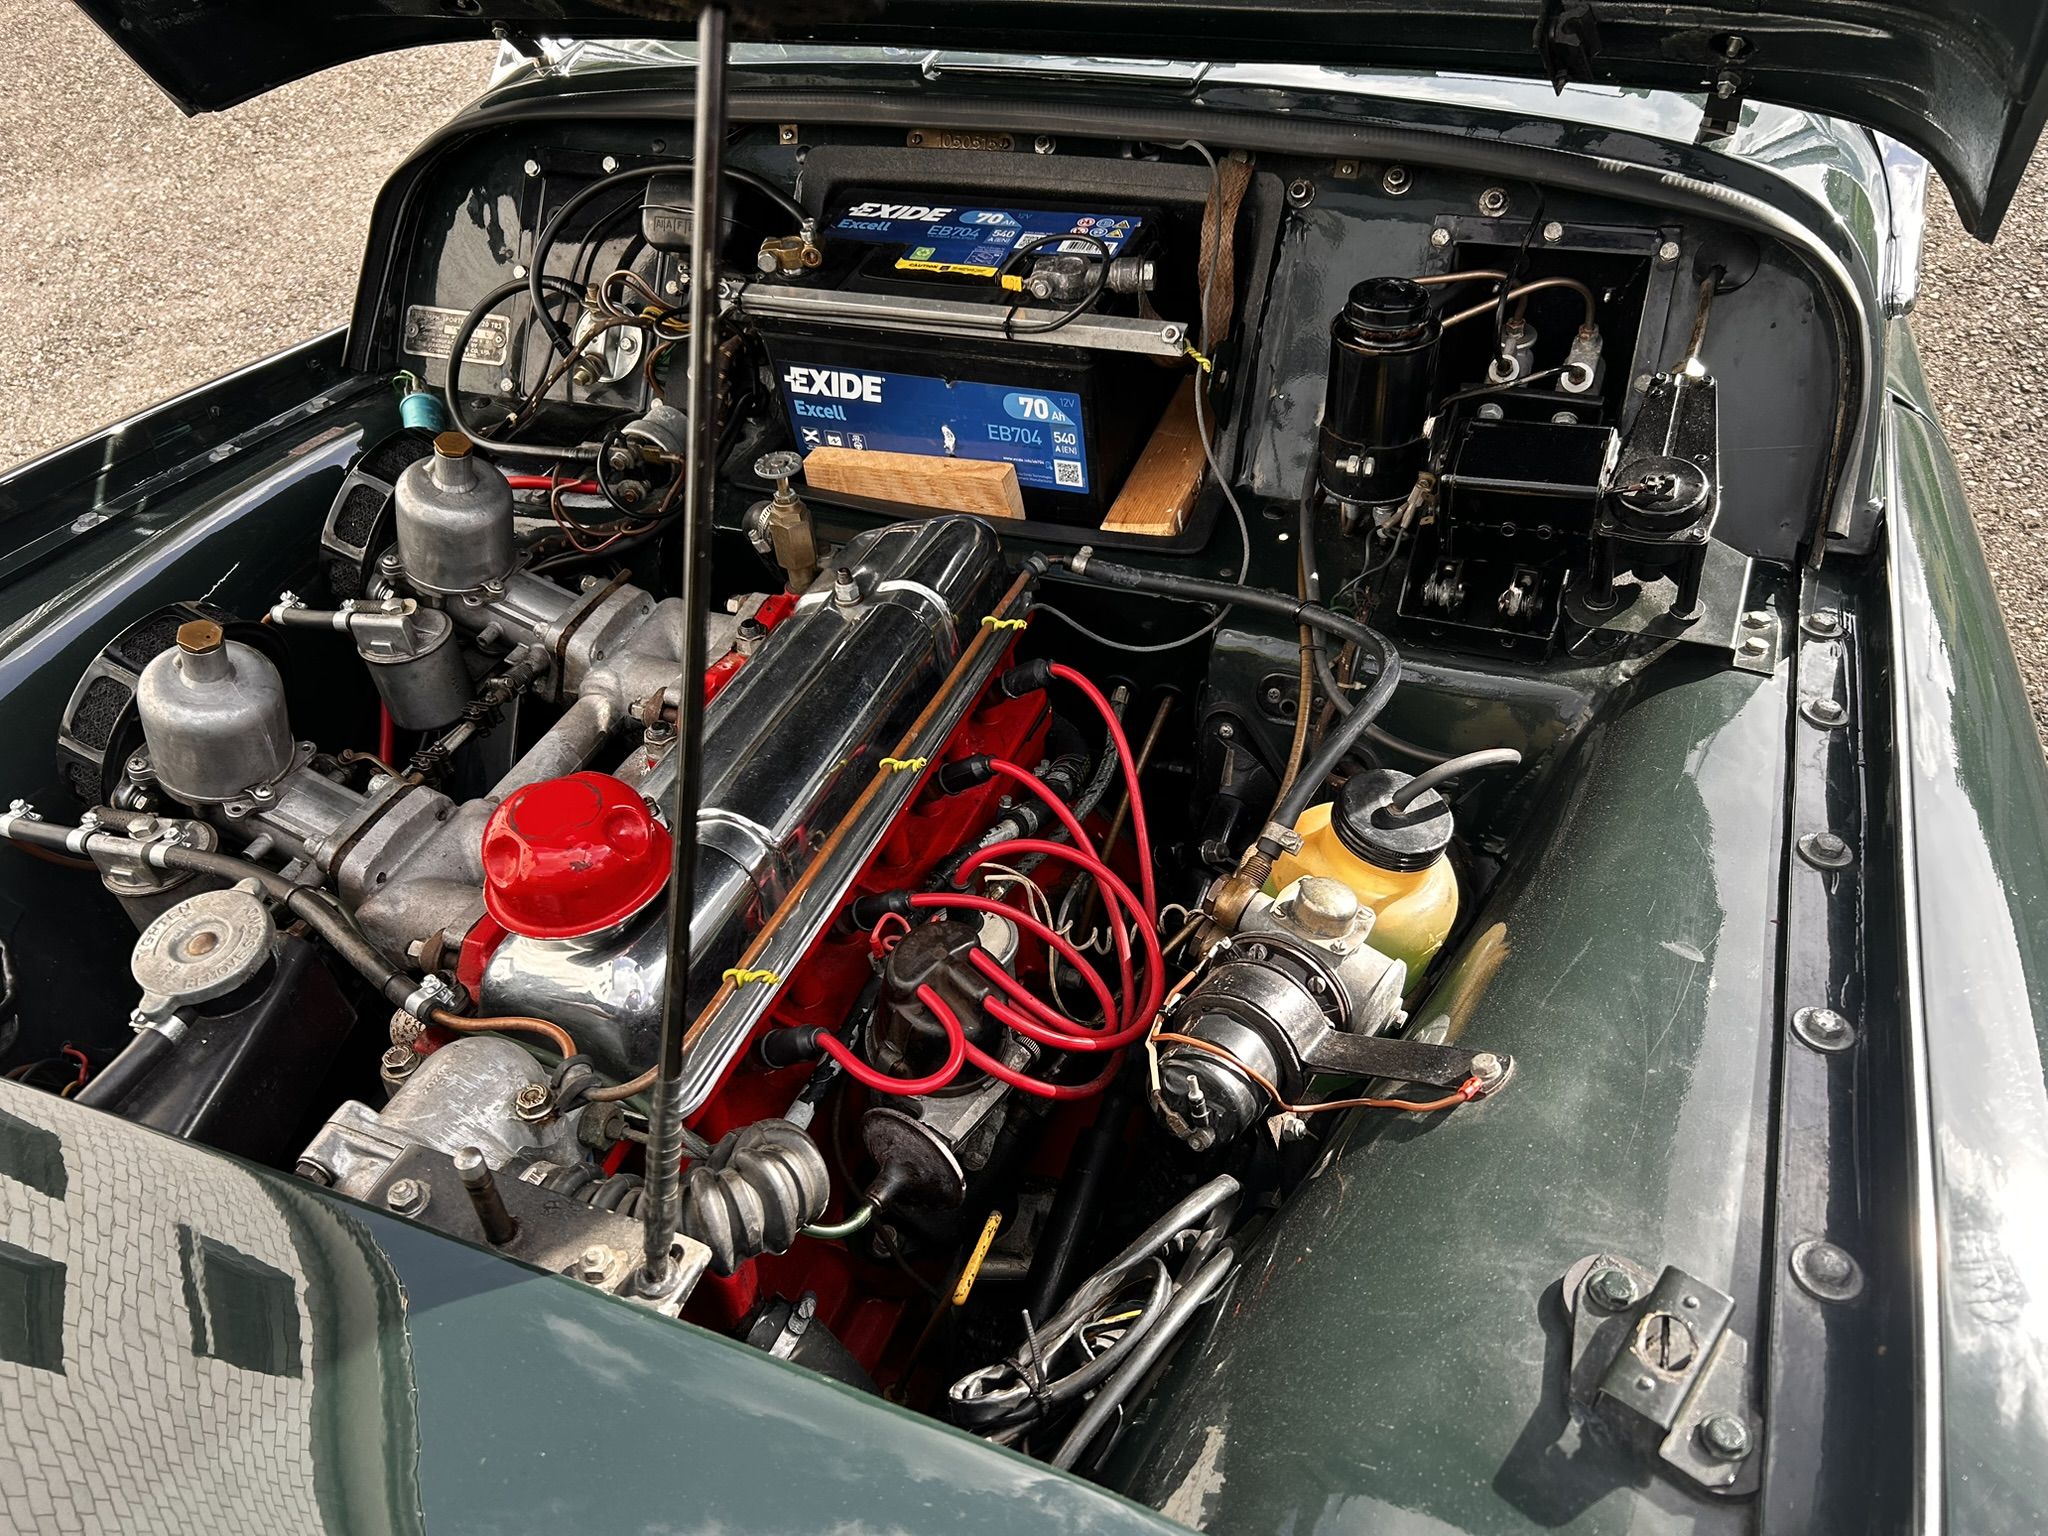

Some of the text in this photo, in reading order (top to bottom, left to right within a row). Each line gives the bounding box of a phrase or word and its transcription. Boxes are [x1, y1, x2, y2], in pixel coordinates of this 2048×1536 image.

[848, 202, 954, 222] EXIDE
[975, 212, 1004, 224] 70
[837, 218, 890, 233] Excell
[926, 225, 980, 239] EB704
[992, 230, 1016, 238] 540
[784, 366, 884, 403] EXIDE
[1018, 396, 1066, 423] 70 Ah
[1059, 397, 1075, 409] 12V
[794, 400, 847, 422] Excell
[988, 424, 1042, 446] EB704
[1053, 431, 1076, 446] 540
